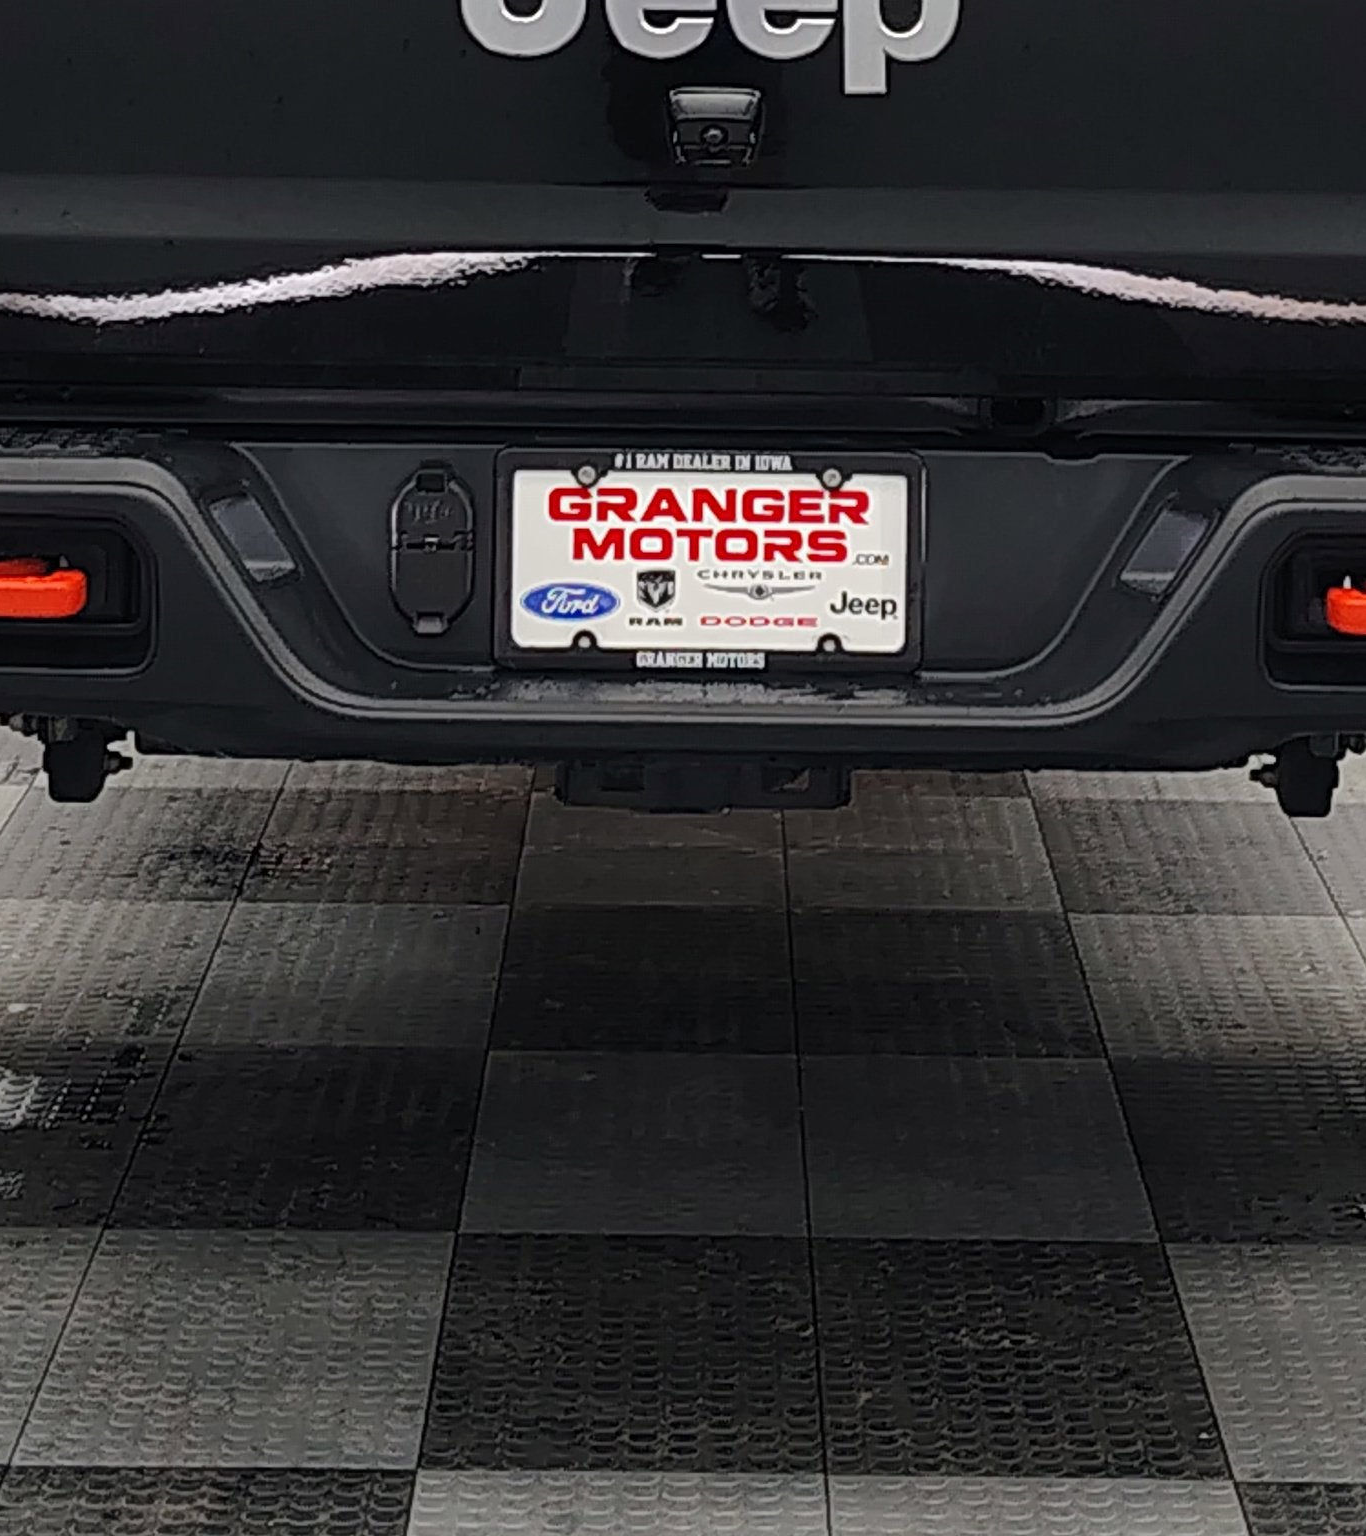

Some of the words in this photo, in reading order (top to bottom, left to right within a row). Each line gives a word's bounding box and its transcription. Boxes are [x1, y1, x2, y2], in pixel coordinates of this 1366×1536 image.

[636, 455, 670, 469] RAM
[673, 456, 731, 470] DEALER
[735, 456, 750, 471] IN
[754, 456, 792, 471] IOWA
[548, 487, 870, 524] GRANGER
[572, 528, 848, 562] MOTORS
[697, 569, 822, 580] CHRYSLER
[541, 586, 599, 615] Ford
[830, 592, 898, 619] Jeep
[629, 617, 683, 626] RAM
[700, 616, 818, 627] DODGE
[637, 653, 702, 668] GRANGER
[705, 653, 765, 668] MOTORS
